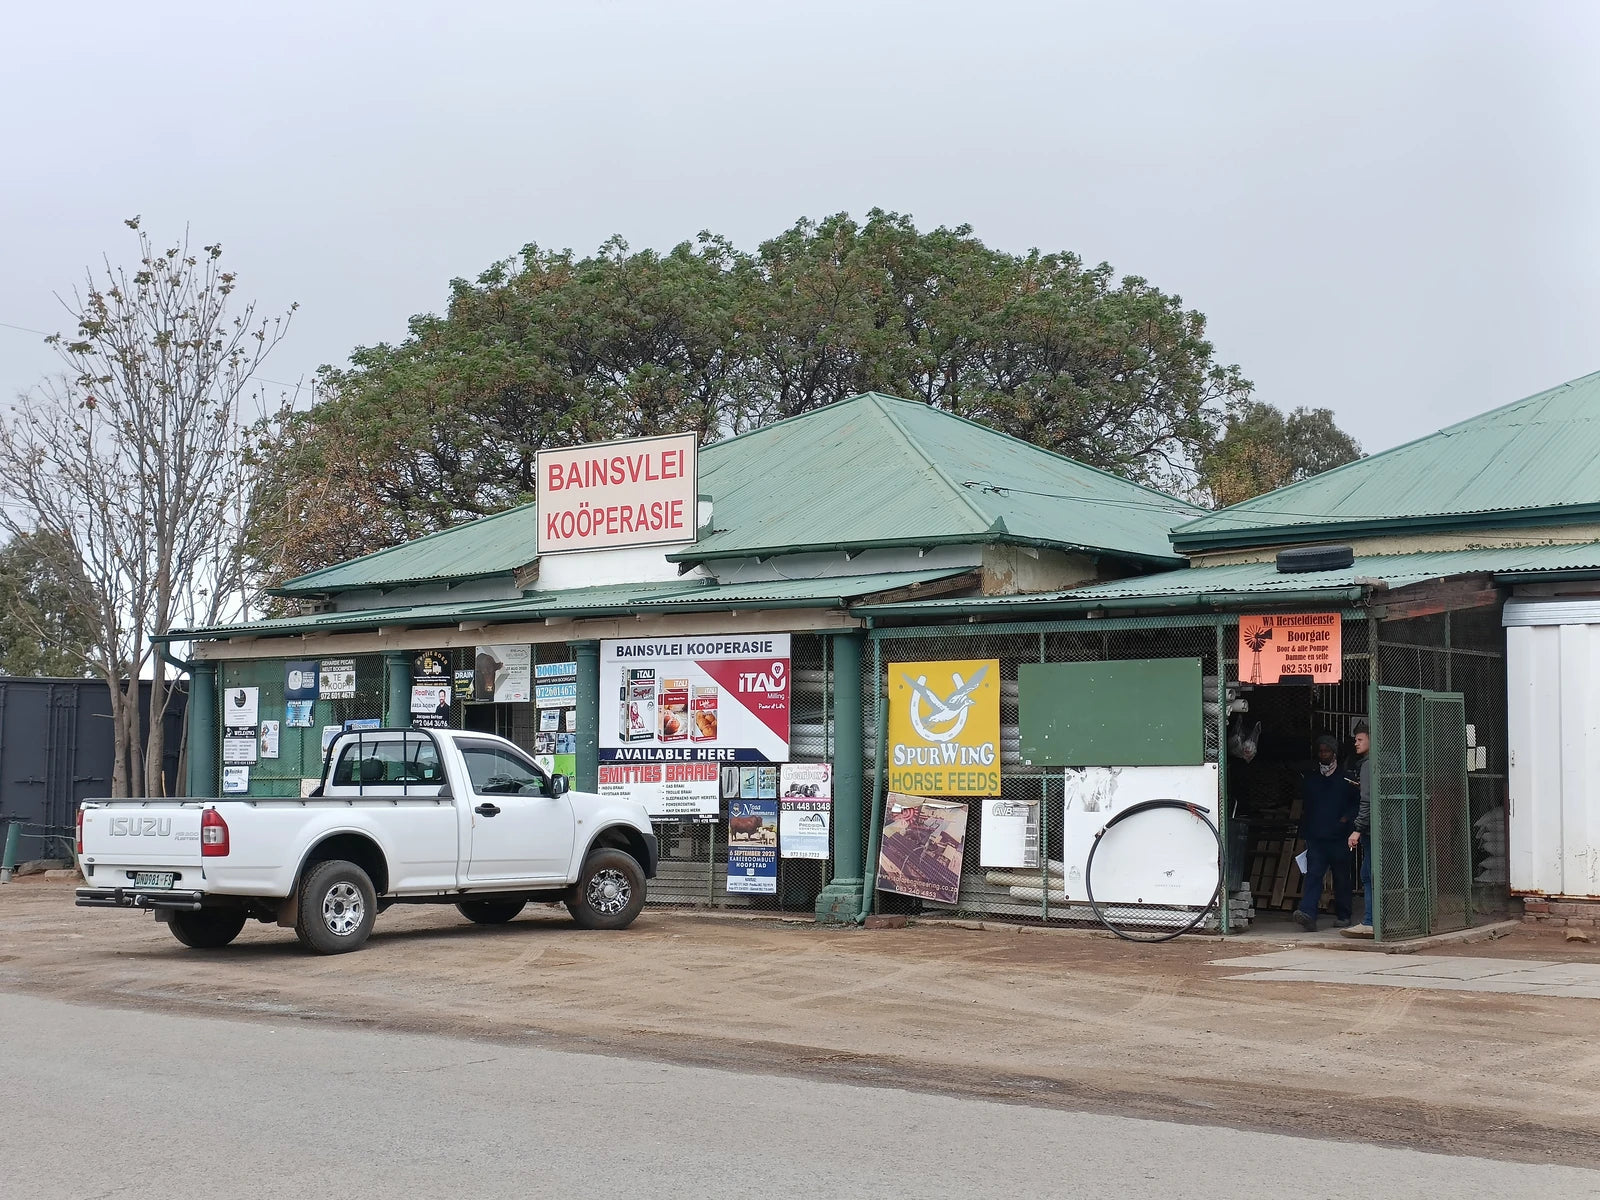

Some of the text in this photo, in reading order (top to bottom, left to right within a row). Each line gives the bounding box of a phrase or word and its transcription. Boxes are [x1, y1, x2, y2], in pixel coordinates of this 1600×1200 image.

[547, 449, 684, 492] BAINSVLEI
[547, 501, 683, 540] KOÖPERASIE
[1262, 615, 1335, 626] WA Hersteldienste
[1287, 630, 1330, 643] Boorgate
[616, 640, 773, 658] BAINSVLEI KOOPERASIE
[1276, 645, 1290, 653] Boor
[1309, 644, 1329, 653] Pompe
[1285, 653, 1307, 661] Damme
[537, 663, 576, 677] BOORGATE
[1281, 663, 1333, 673] 082 535 0197
[455, 671, 474, 679] DRAIN
[329, 682, 346, 690] KOOP
[536, 685, 577, 697] 0726014678
[614, 749, 736, 761] AVAILABLE HERE
[599, 763, 719, 785] SMITTIES BRAAIS
[892, 771, 998, 791] HORSE FEEDS
[781, 802, 831, 811] 051 448 1348
[109, 818, 172, 837] ISUZU
[163, 874, 173, 886] FS
